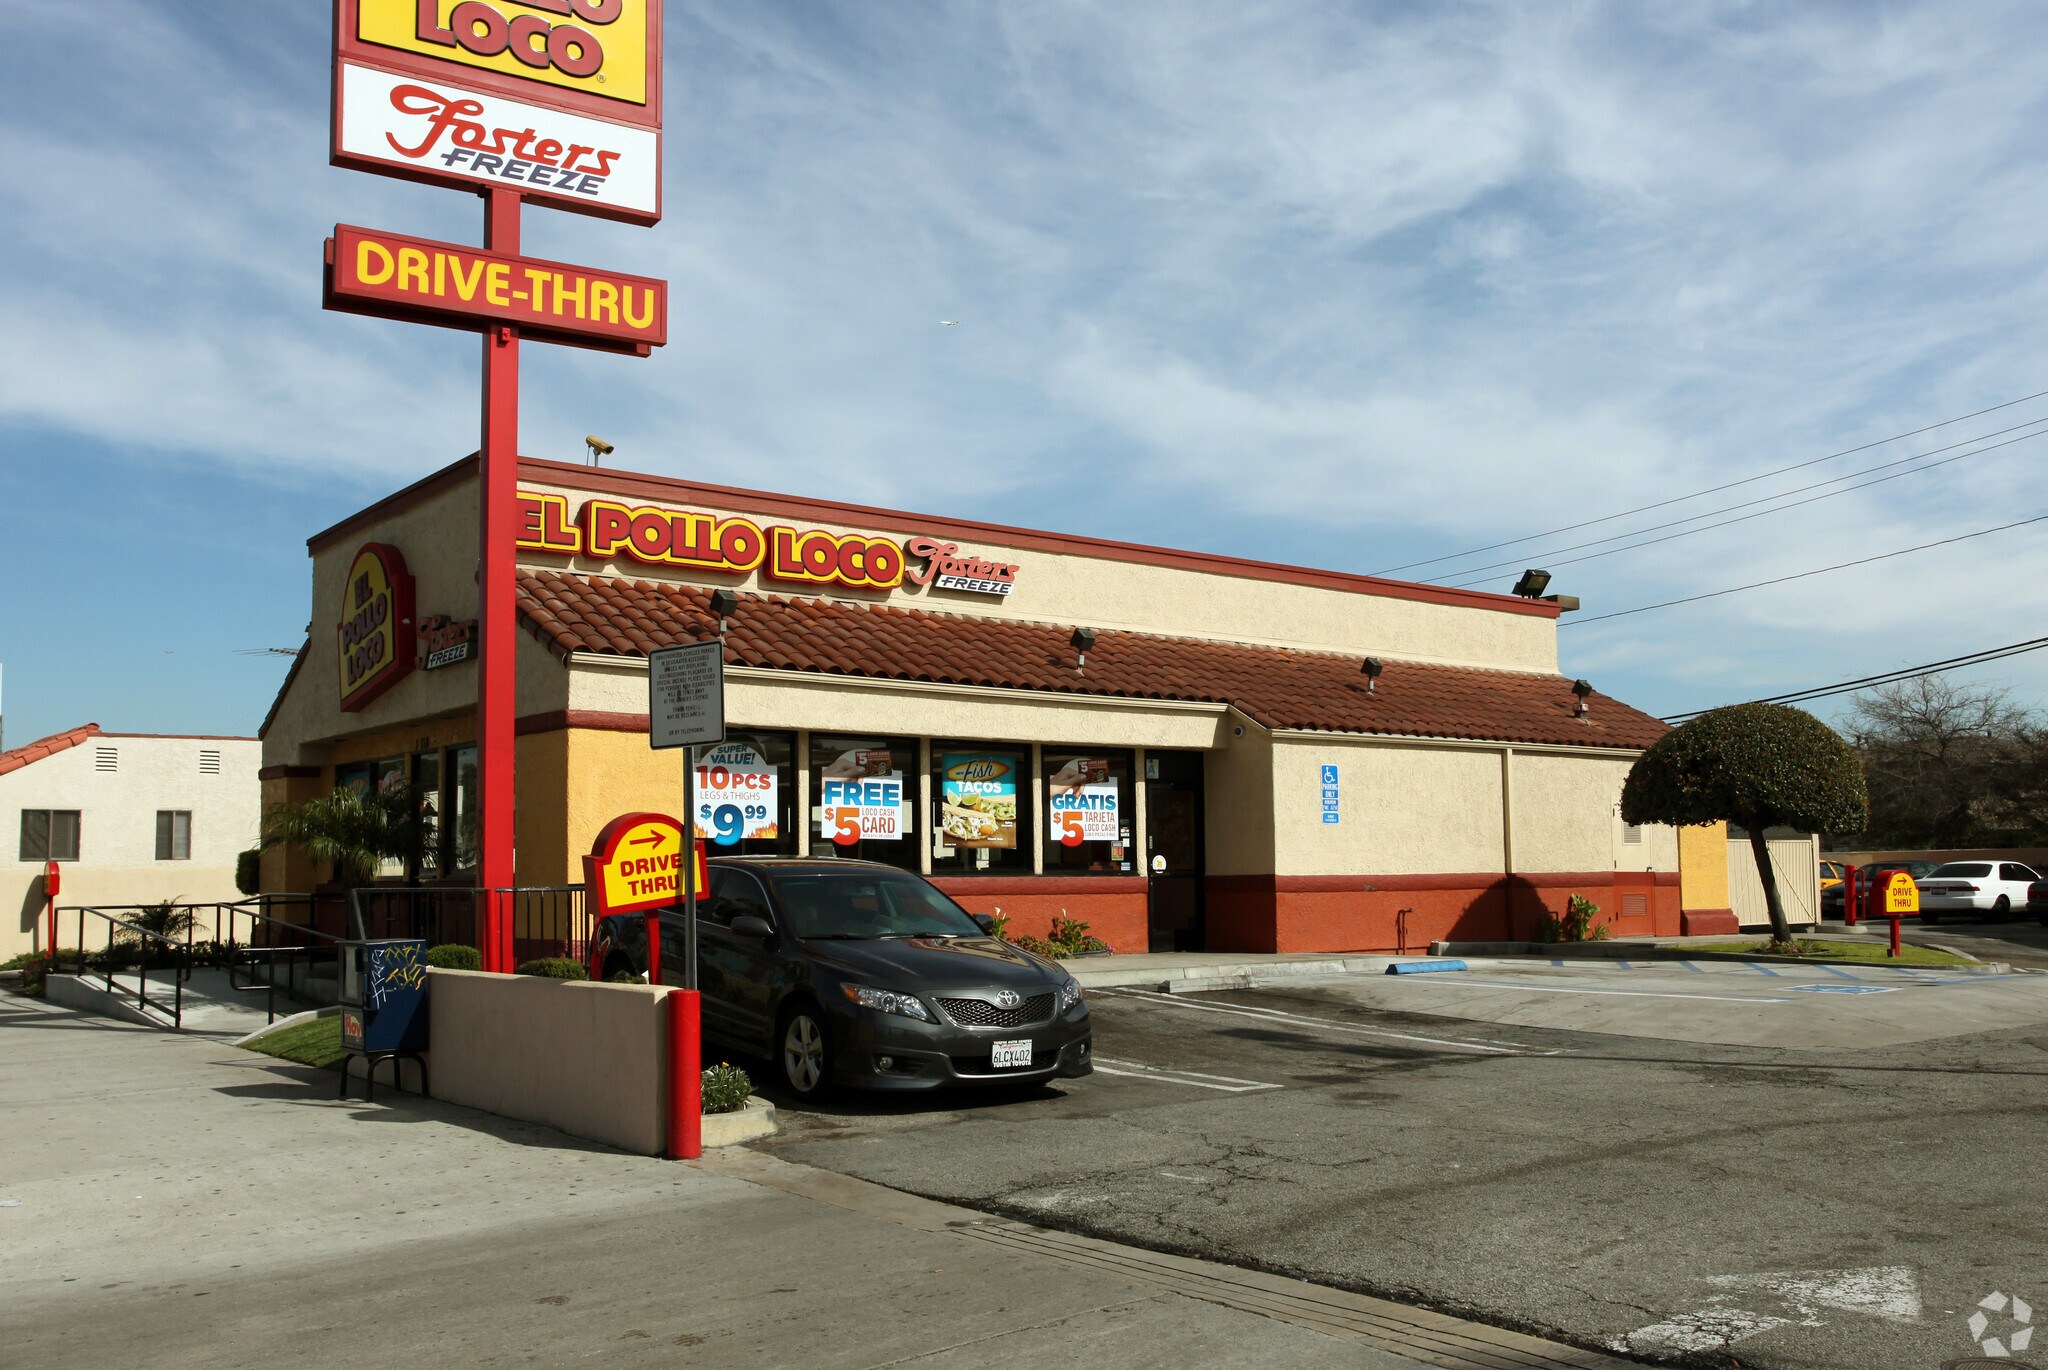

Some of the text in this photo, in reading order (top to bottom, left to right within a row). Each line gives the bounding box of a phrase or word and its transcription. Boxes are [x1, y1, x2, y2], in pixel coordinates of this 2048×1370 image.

[415, 0, 604, 78] LOCO
[385, 84, 622, 177] Fosters
[440, 148, 606, 196] FREEZE
[356, 240, 655, 329] DRIVE-THRU
[516, 496, 901, 583] EL POLLO LOCO
[909, 536, 1020, 585] Fosters
[354, 571, 373, 609] EL
[941, 576, 1012, 594] FREEZE
[343, 592, 388, 655] POLLO
[347, 630, 385, 686] LOCO
[429, 644, 467, 667] FREEZE
[683, 649, 700, 657] VEHICLES
[710, 753, 756, 765] VALUE!
[717, 744, 748, 753] SUPER
[696, 765, 771, 790] 10 PCS
[962, 758, 994, 782] Fish
[700, 791, 760, 800] LEGS & THIGHS
[824, 781, 900, 807] FREE
[956, 781, 1002, 793] TACOS
[862, 808, 895, 816] LOCO CASH
[1052, 794, 1116, 810] GRATIS
[824, 807, 861, 846] $5
[862, 816, 895, 834] CARD
[1084, 811, 1115, 823] TARJETA
[1084, 823, 1100, 832] LOCO
[1101, 823, 1116, 832] CASH
[1053, 811, 1085, 847] $5
[620, 853, 683, 877] DRIVE
[627, 875, 680, 897] THRU
[1892, 887, 1912, 896] DRIVE
[1893, 898, 1912, 907] THRU
[344, 1014, 362, 1040] Hoy
[993, 1049, 1030, 1063] 6LCX402
